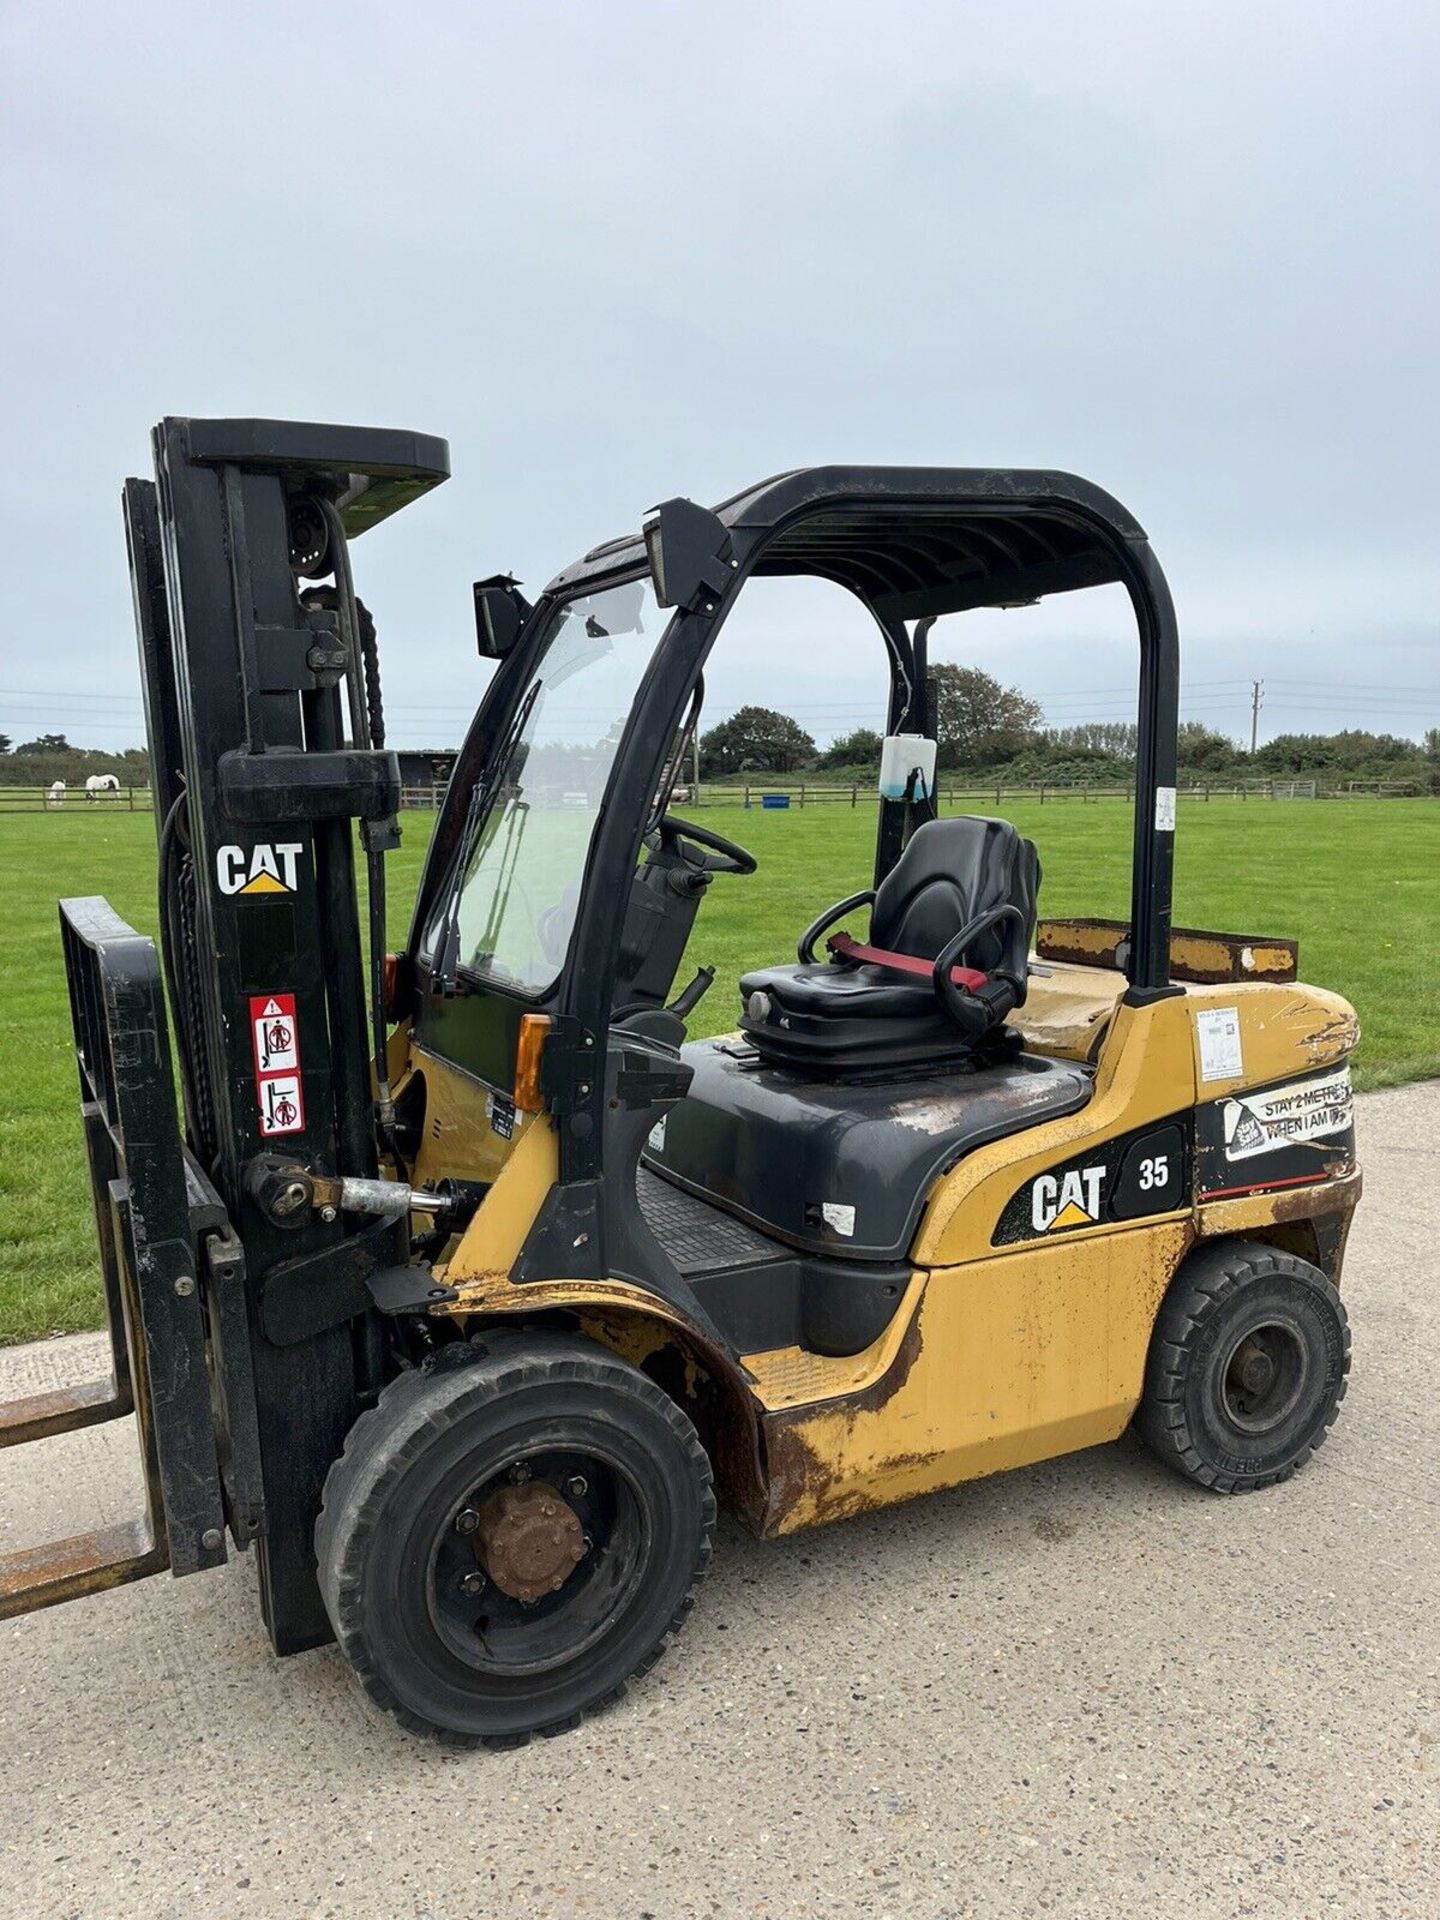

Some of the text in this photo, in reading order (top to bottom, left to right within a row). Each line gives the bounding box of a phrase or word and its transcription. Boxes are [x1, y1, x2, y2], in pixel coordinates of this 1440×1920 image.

[216, 843, 303, 895] CAT
[1265, 1097, 1294, 1117] STAY
[1296, 1094, 1303, 1109] 2
[1266, 1115, 1303, 1140] WHEN
[1309, 1110, 1328, 1129] AM
[1139, 1156, 1169, 1191] 35
[1032, 1165, 1107, 1231] CAT
